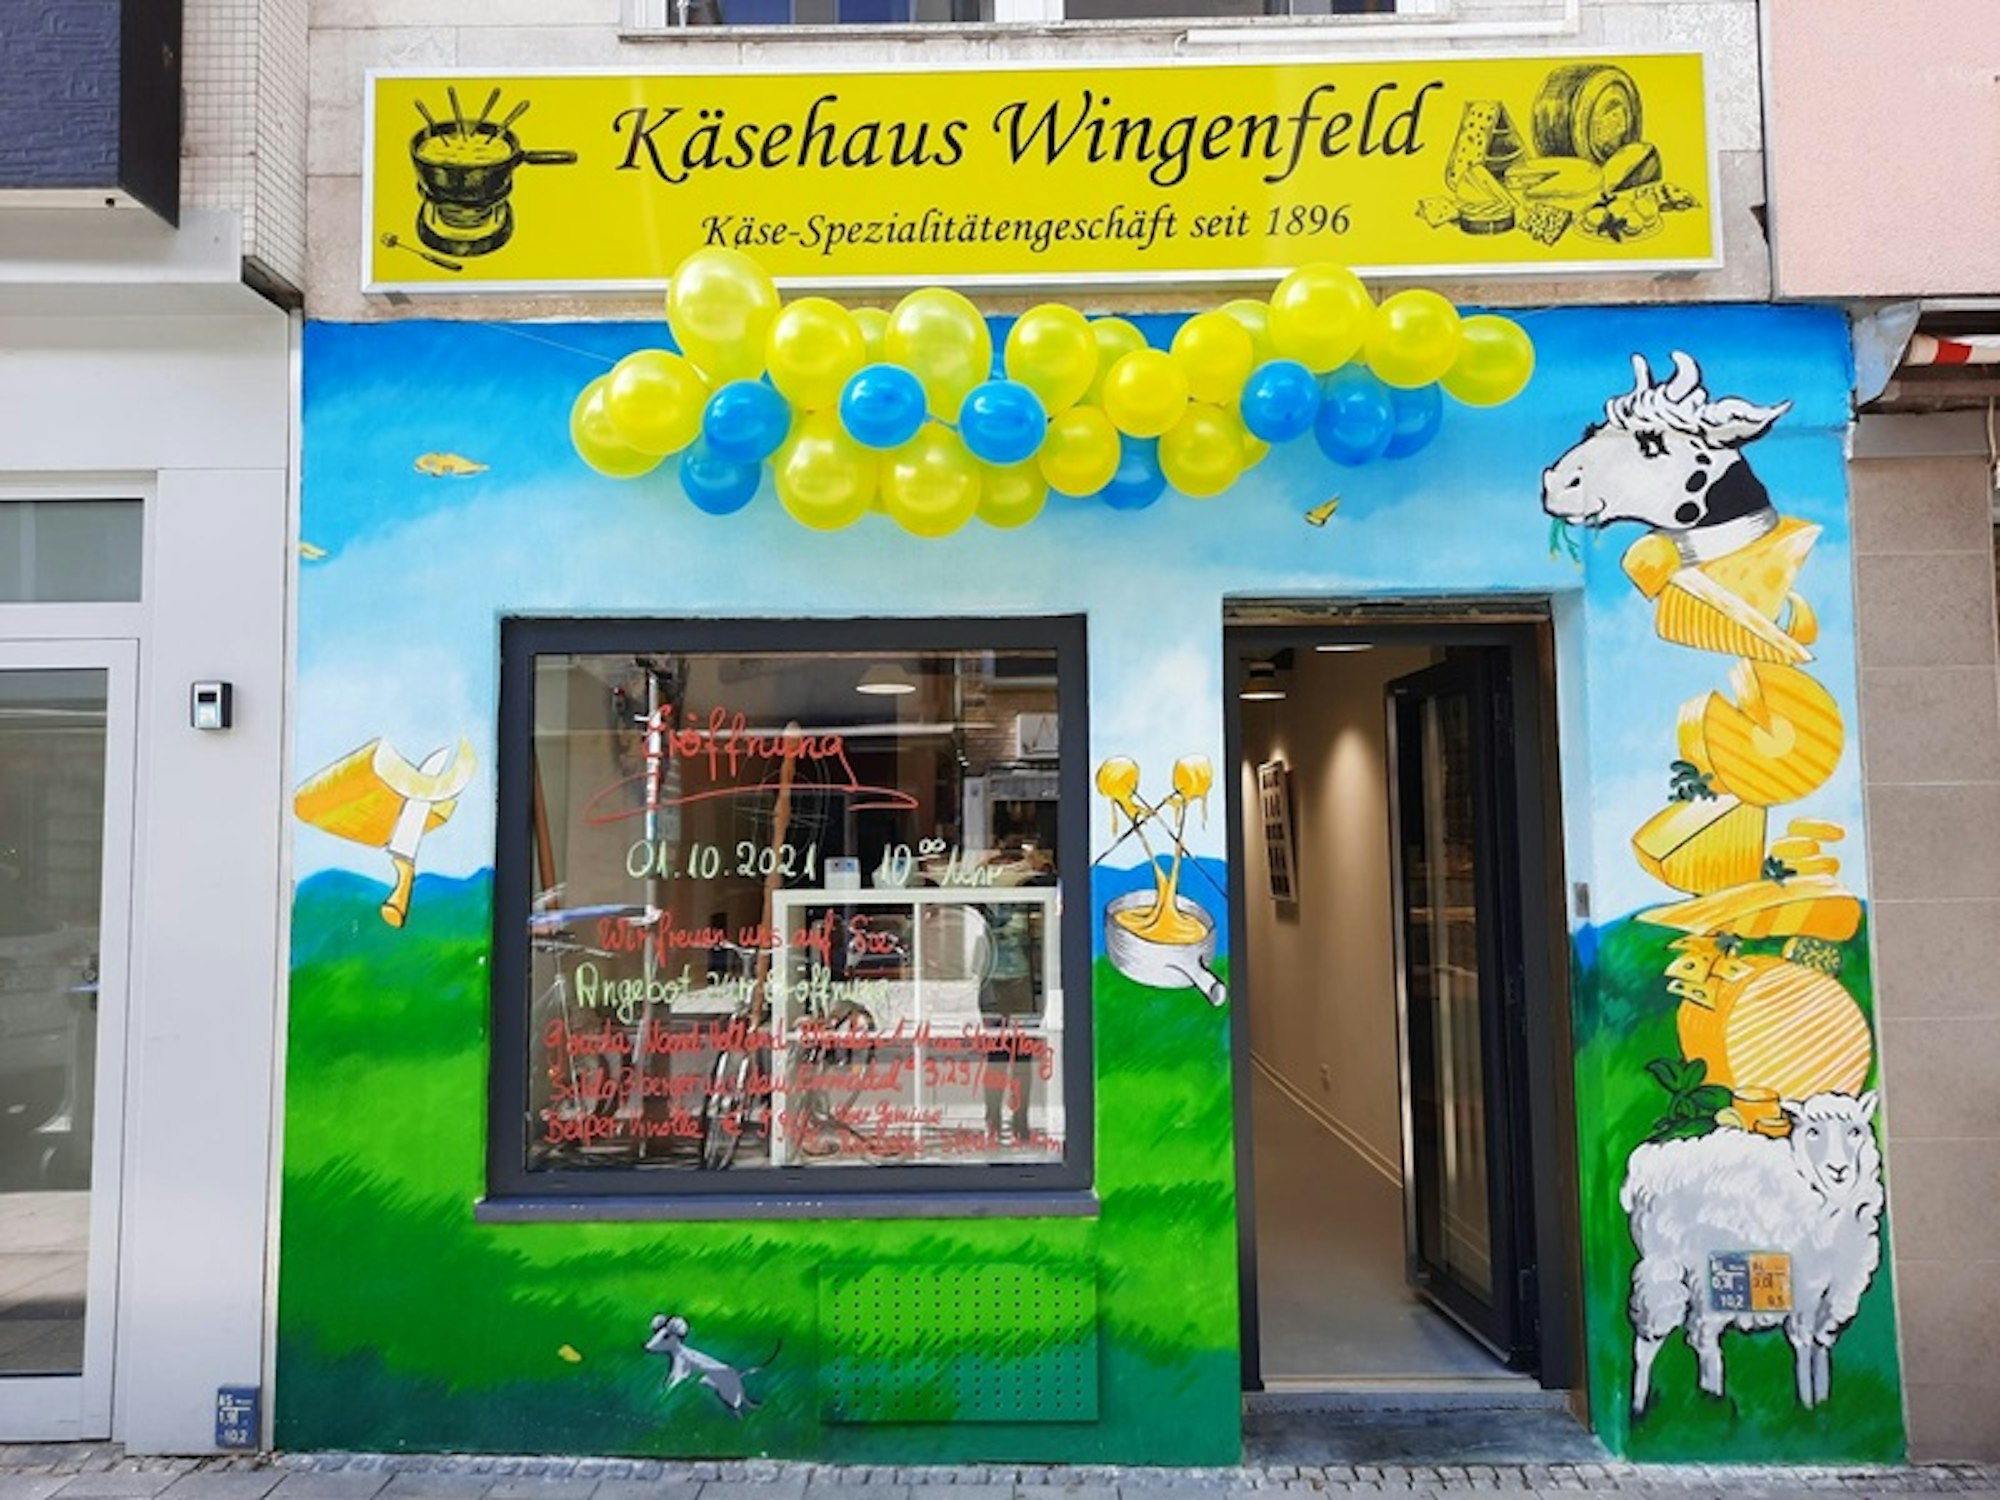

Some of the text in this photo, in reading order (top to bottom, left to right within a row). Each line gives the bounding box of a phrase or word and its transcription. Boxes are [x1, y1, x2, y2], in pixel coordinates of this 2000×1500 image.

[612, 82, 1446, 187] Käsehaus Wingenfeld
[701, 204, 1352, 256] Käse-Spezialitätengeschäft seit 1896
[640, 703, 858, 787] Eröffnung
[626, 839, 817, 882] 01.10.2021
[598, 918, 646, 951] Wir
[655, 911, 727, 967] freuen
[739, 926, 782, 949] uns
[790, 909, 835, 966] auf
[575, 962, 692, 1023] Angebot
